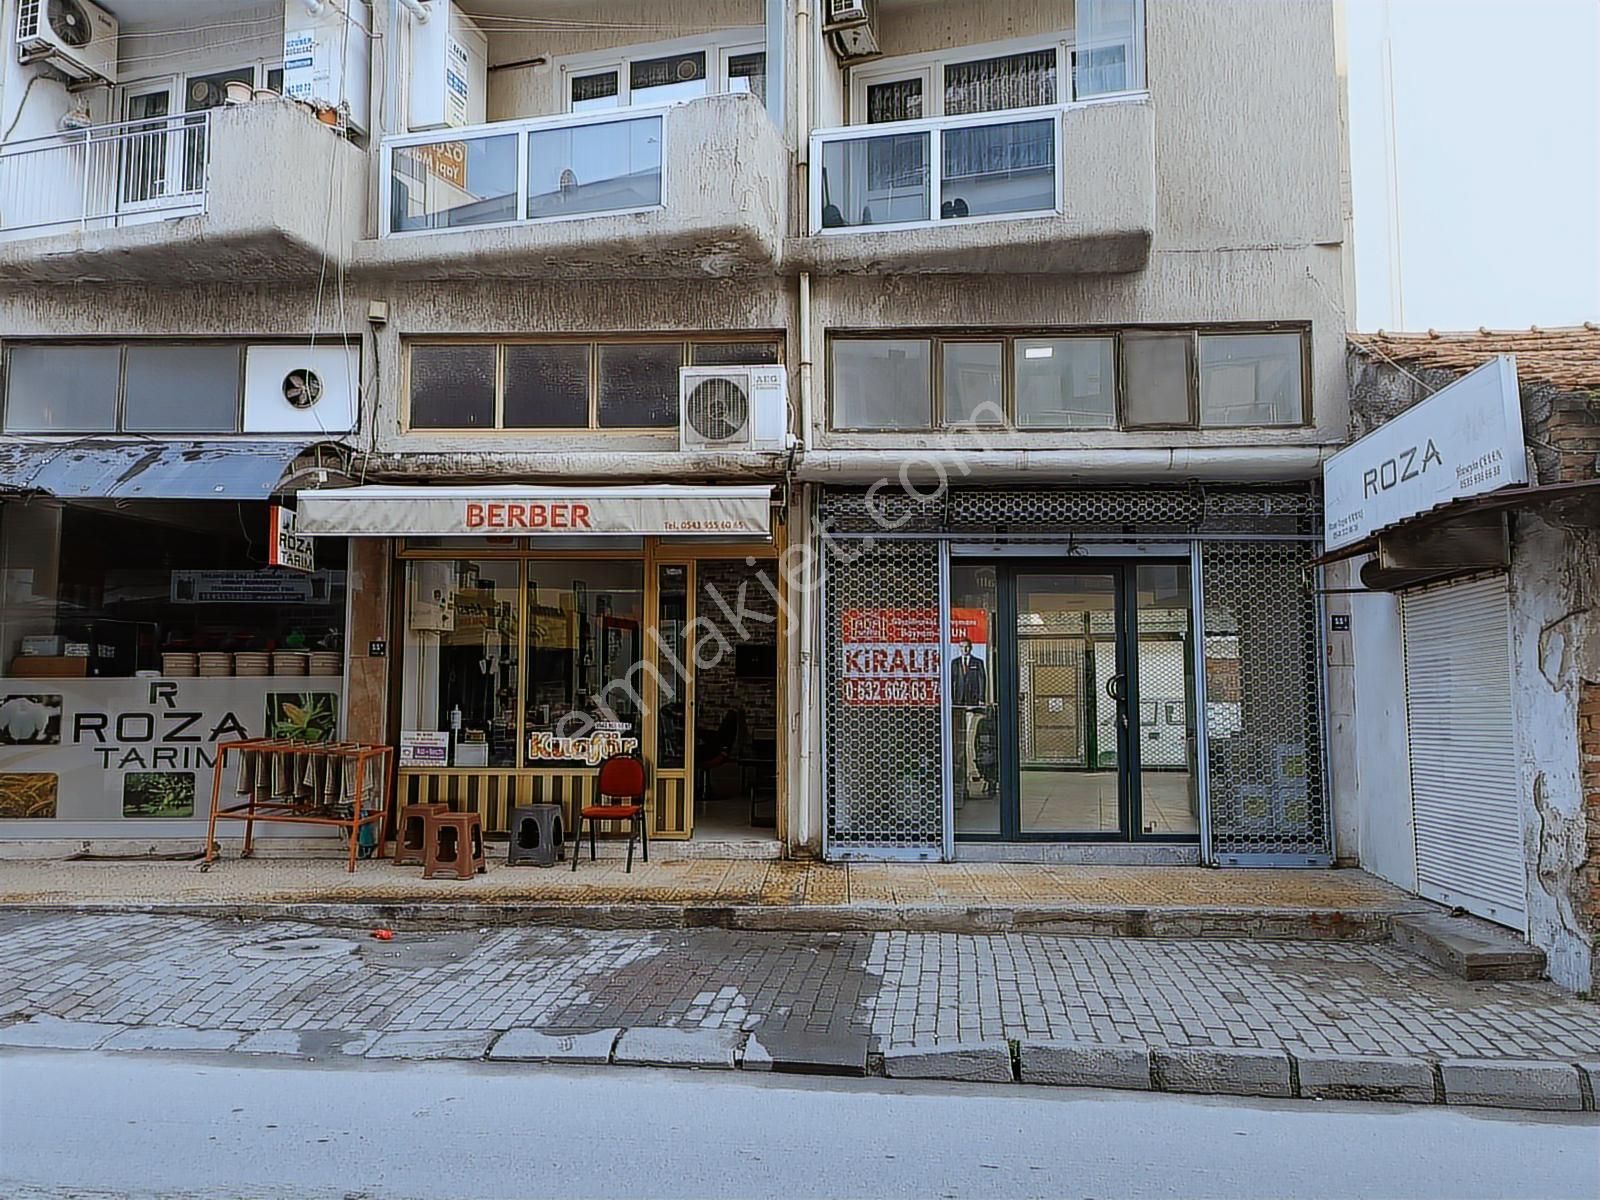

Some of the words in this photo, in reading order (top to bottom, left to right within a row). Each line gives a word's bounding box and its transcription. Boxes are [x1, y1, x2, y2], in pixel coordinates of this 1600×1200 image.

[1363, 438, 1443, 499] ROZA
[466, 503, 592, 528] BERBER
[280, 533, 313, 556] ROZA
[149, 681, 178, 709] R
[73, 711, 248, 743] ROZA
[94, 747, 229, 769] TARIM
[529, 731, 638, 765] Kuaför
